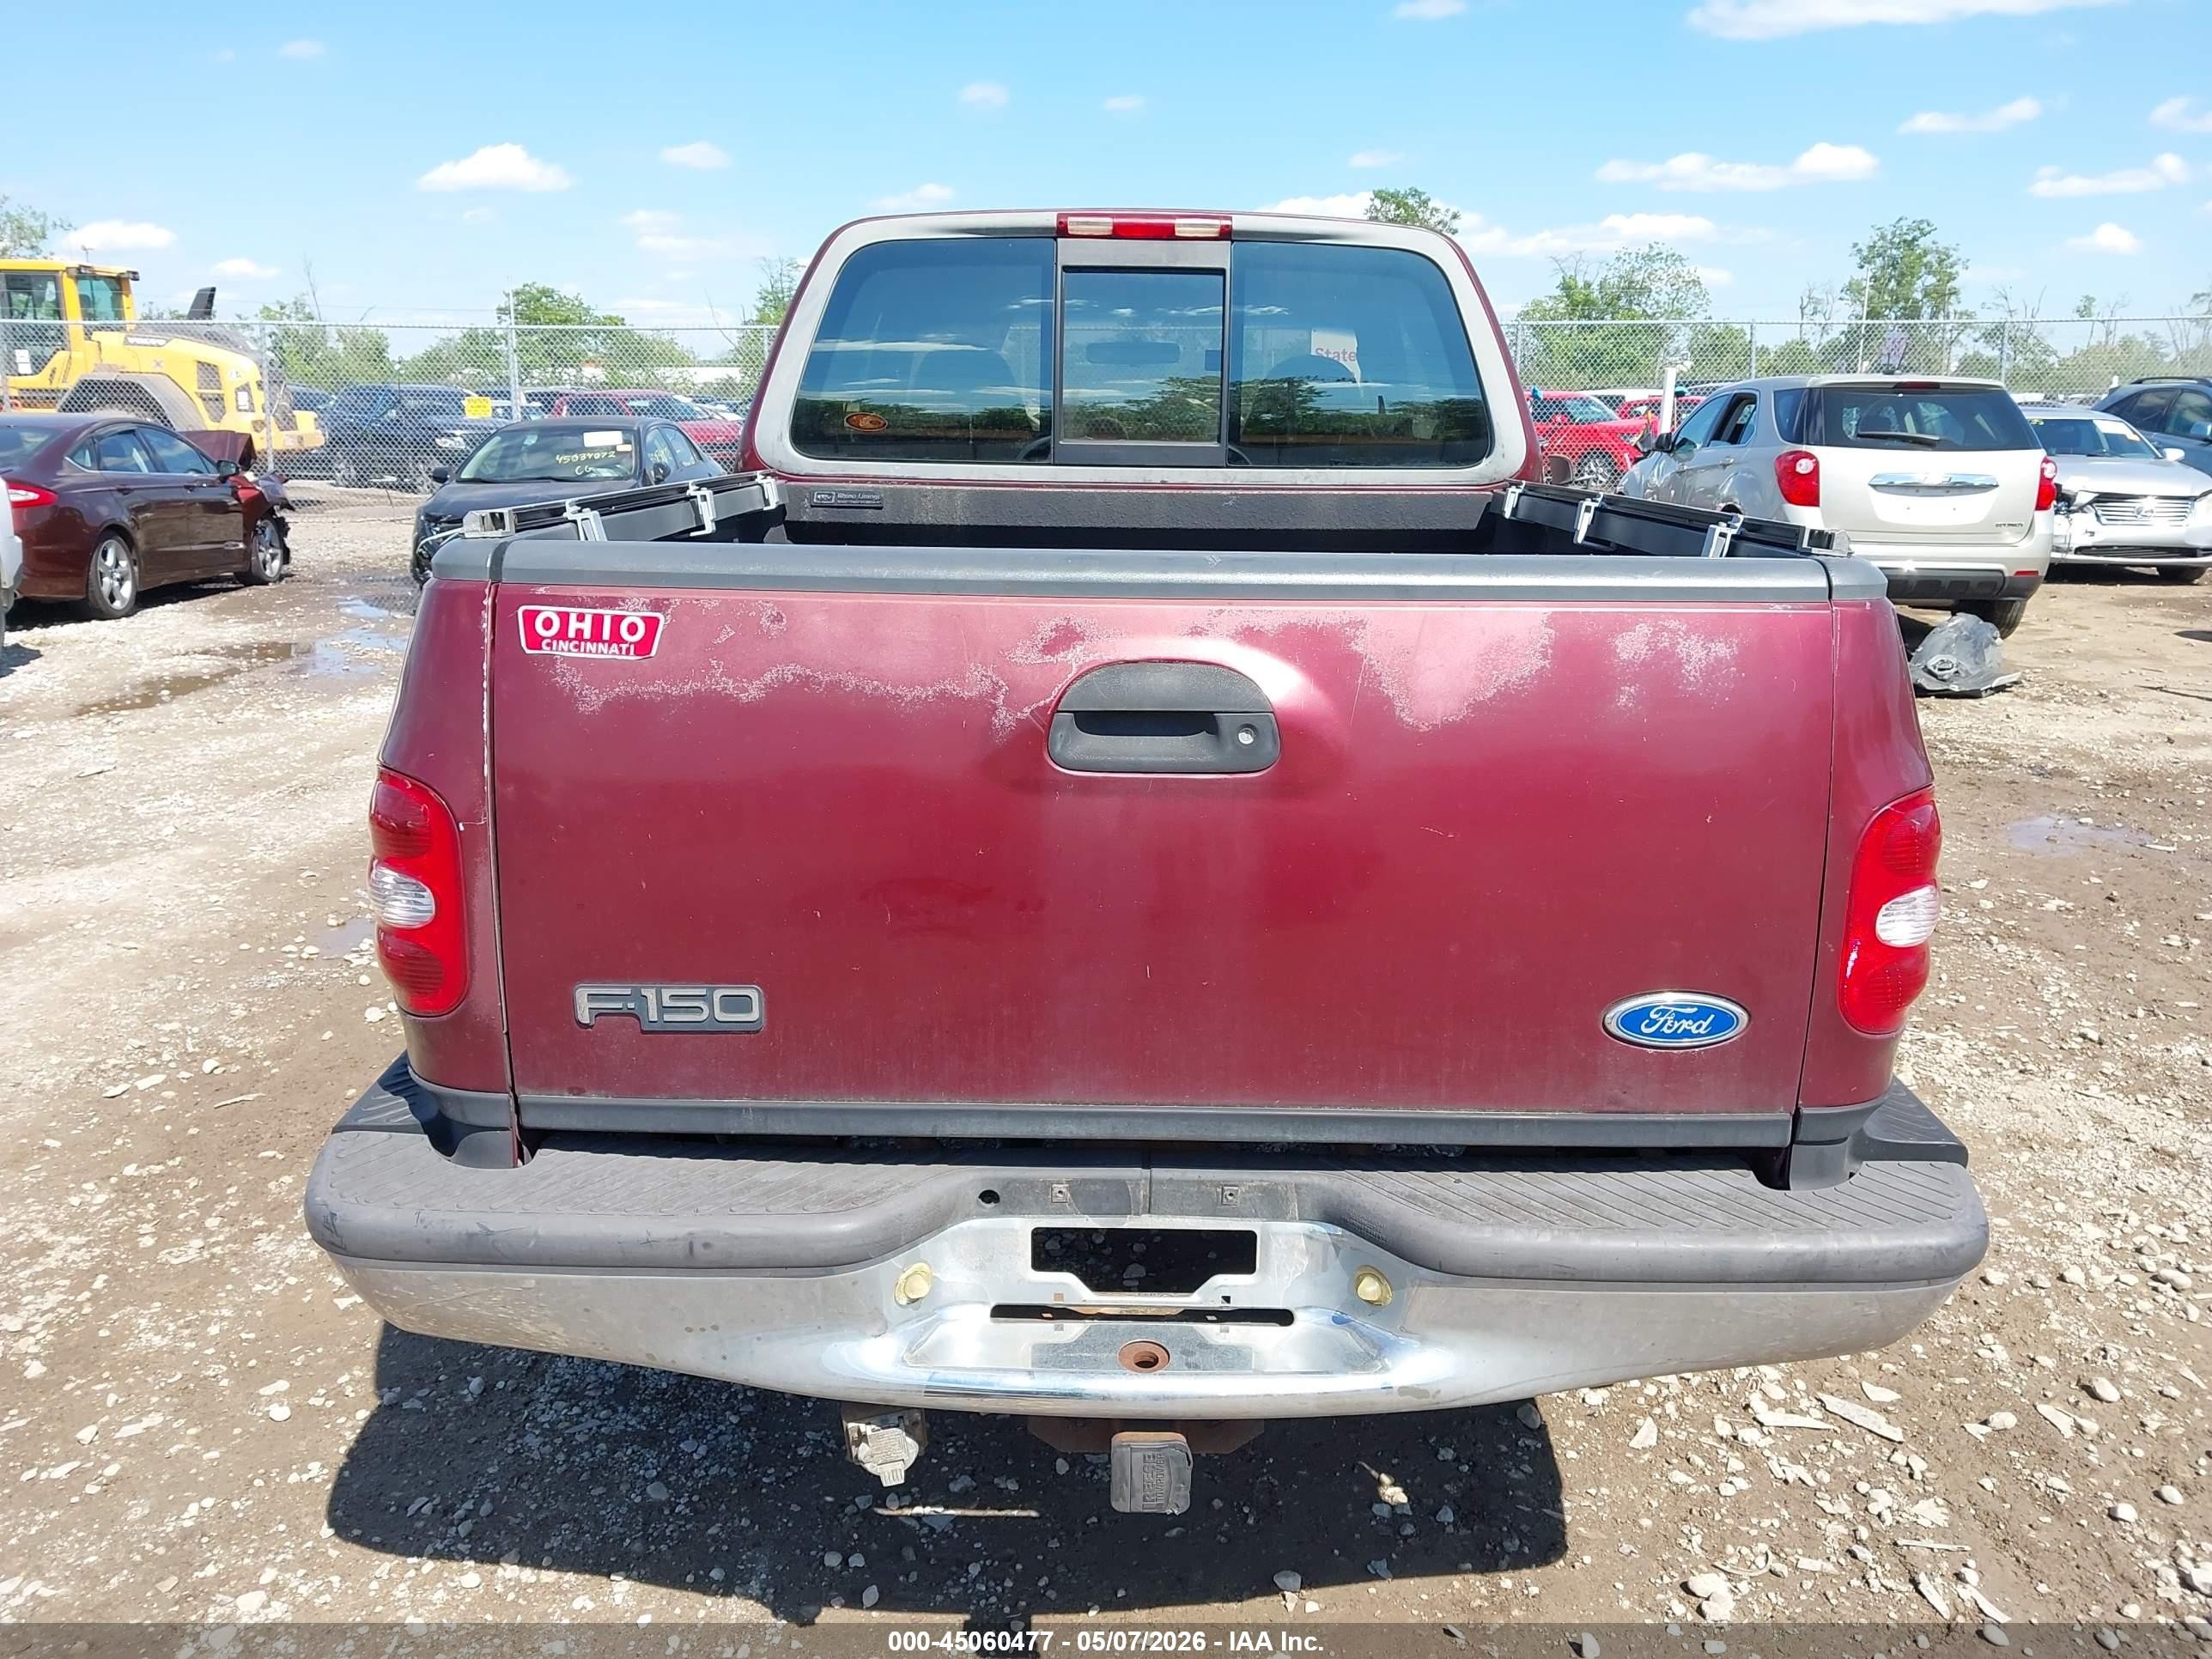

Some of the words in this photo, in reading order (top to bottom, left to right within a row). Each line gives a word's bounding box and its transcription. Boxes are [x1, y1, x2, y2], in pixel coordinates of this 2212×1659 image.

[1315, 348, 1356, 362] State
[534, 611, 646, 643] OHIO
[541, 639, 635, 656] CINCINNATI
[574, 988, 761, 1024] F-150
[1640, 1005, 1716, 1035] Ford
[1142, 1453, 1156, 1503] REESE
